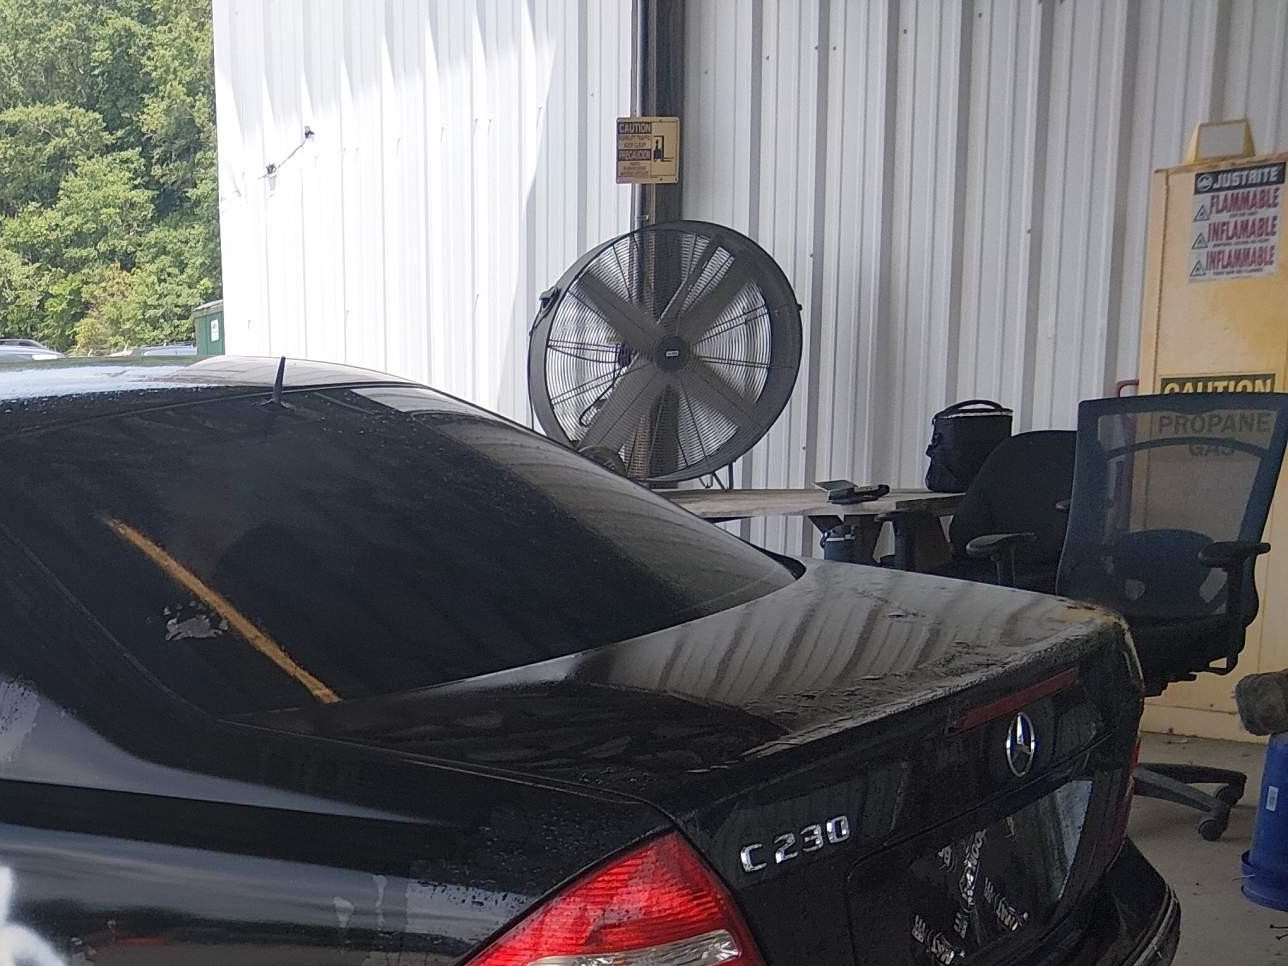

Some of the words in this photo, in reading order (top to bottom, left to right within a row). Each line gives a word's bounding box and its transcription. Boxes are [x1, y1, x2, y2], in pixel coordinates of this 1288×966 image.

[618, 123, 651, 133] CAUTION
[1213, 166, 1279, 189] JUSTRITE
[1209, 187, 1280, 215] FLAMMABLE
[1207, 215, 1278, 242] INFLAMABLE
[1205, 245, 1276, 271] INFLAMMABLE
[1159, 411, 1272, 435] PROPANE
[740, 843, 768, 872] C
[774, 815, 851, 864] 230
